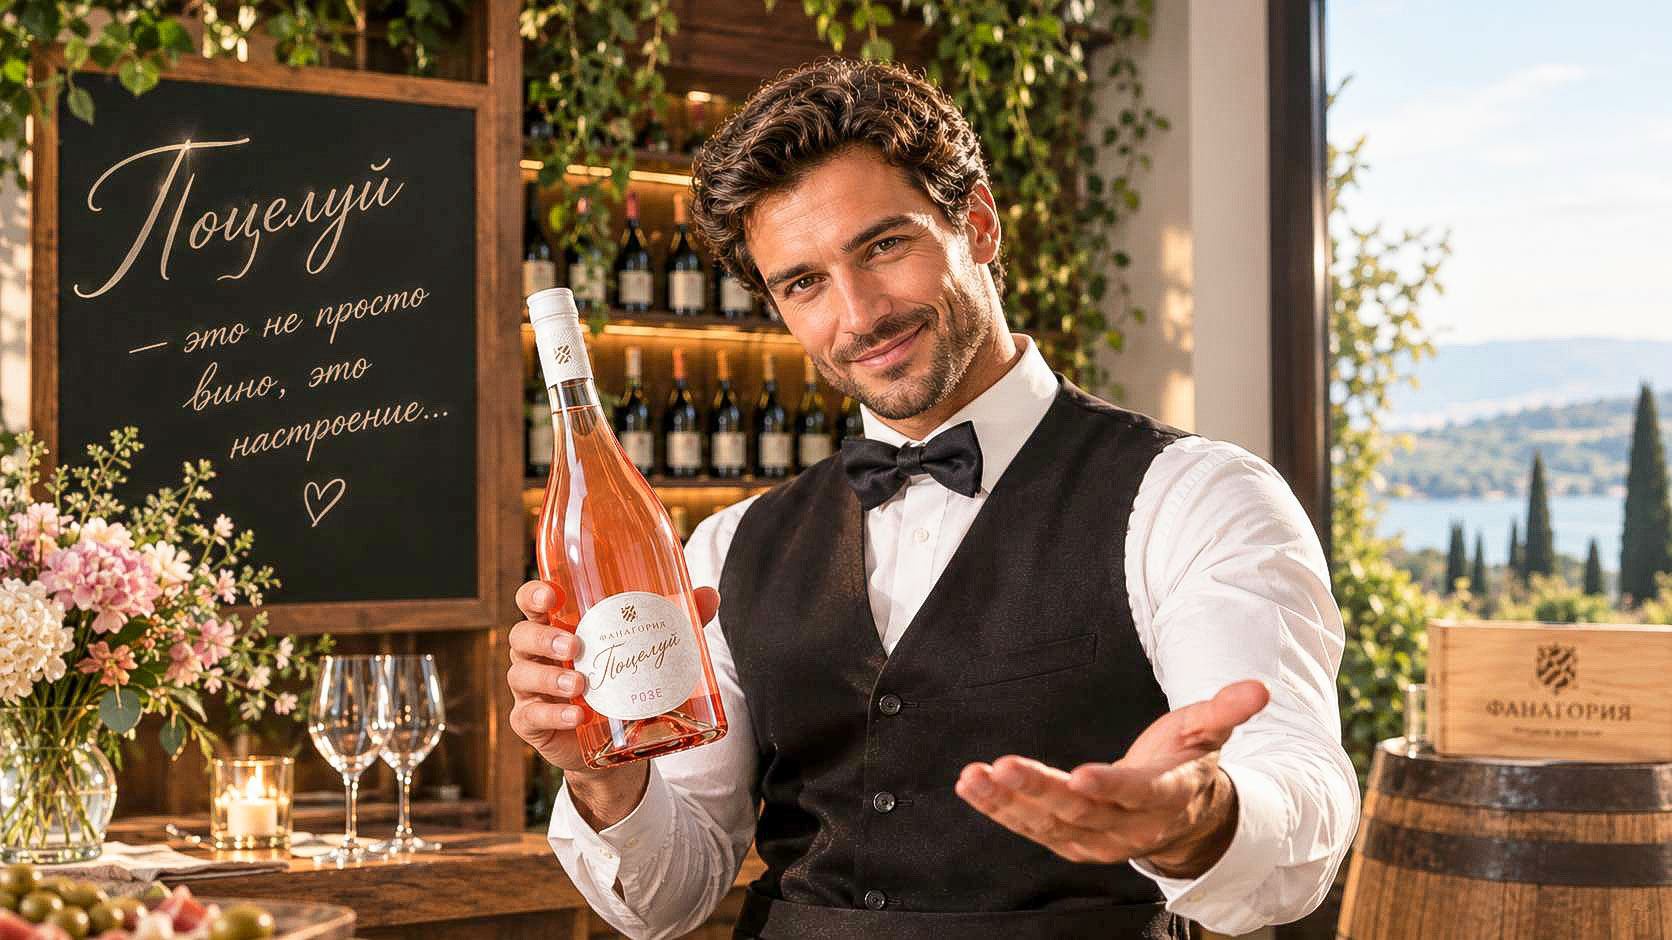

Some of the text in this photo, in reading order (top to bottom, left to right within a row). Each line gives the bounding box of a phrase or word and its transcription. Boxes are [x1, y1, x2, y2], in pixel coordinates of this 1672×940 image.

[73, 137, 404, 298] Поцелуй
[183, 322, 250, 353] это
[263, 309, 305, 339] не
[315, 287, 430, 345] просто
[182, 357, 373, 411] вино, это
[599, 620, 667, 641] ФАНАГОРИЯ
[588, 632, 681, 690] Поцелуй
[630, 687, 664, 704] РОЗЕ
[1486, 700, 1632, 722] ФАНАГОРИЯ
